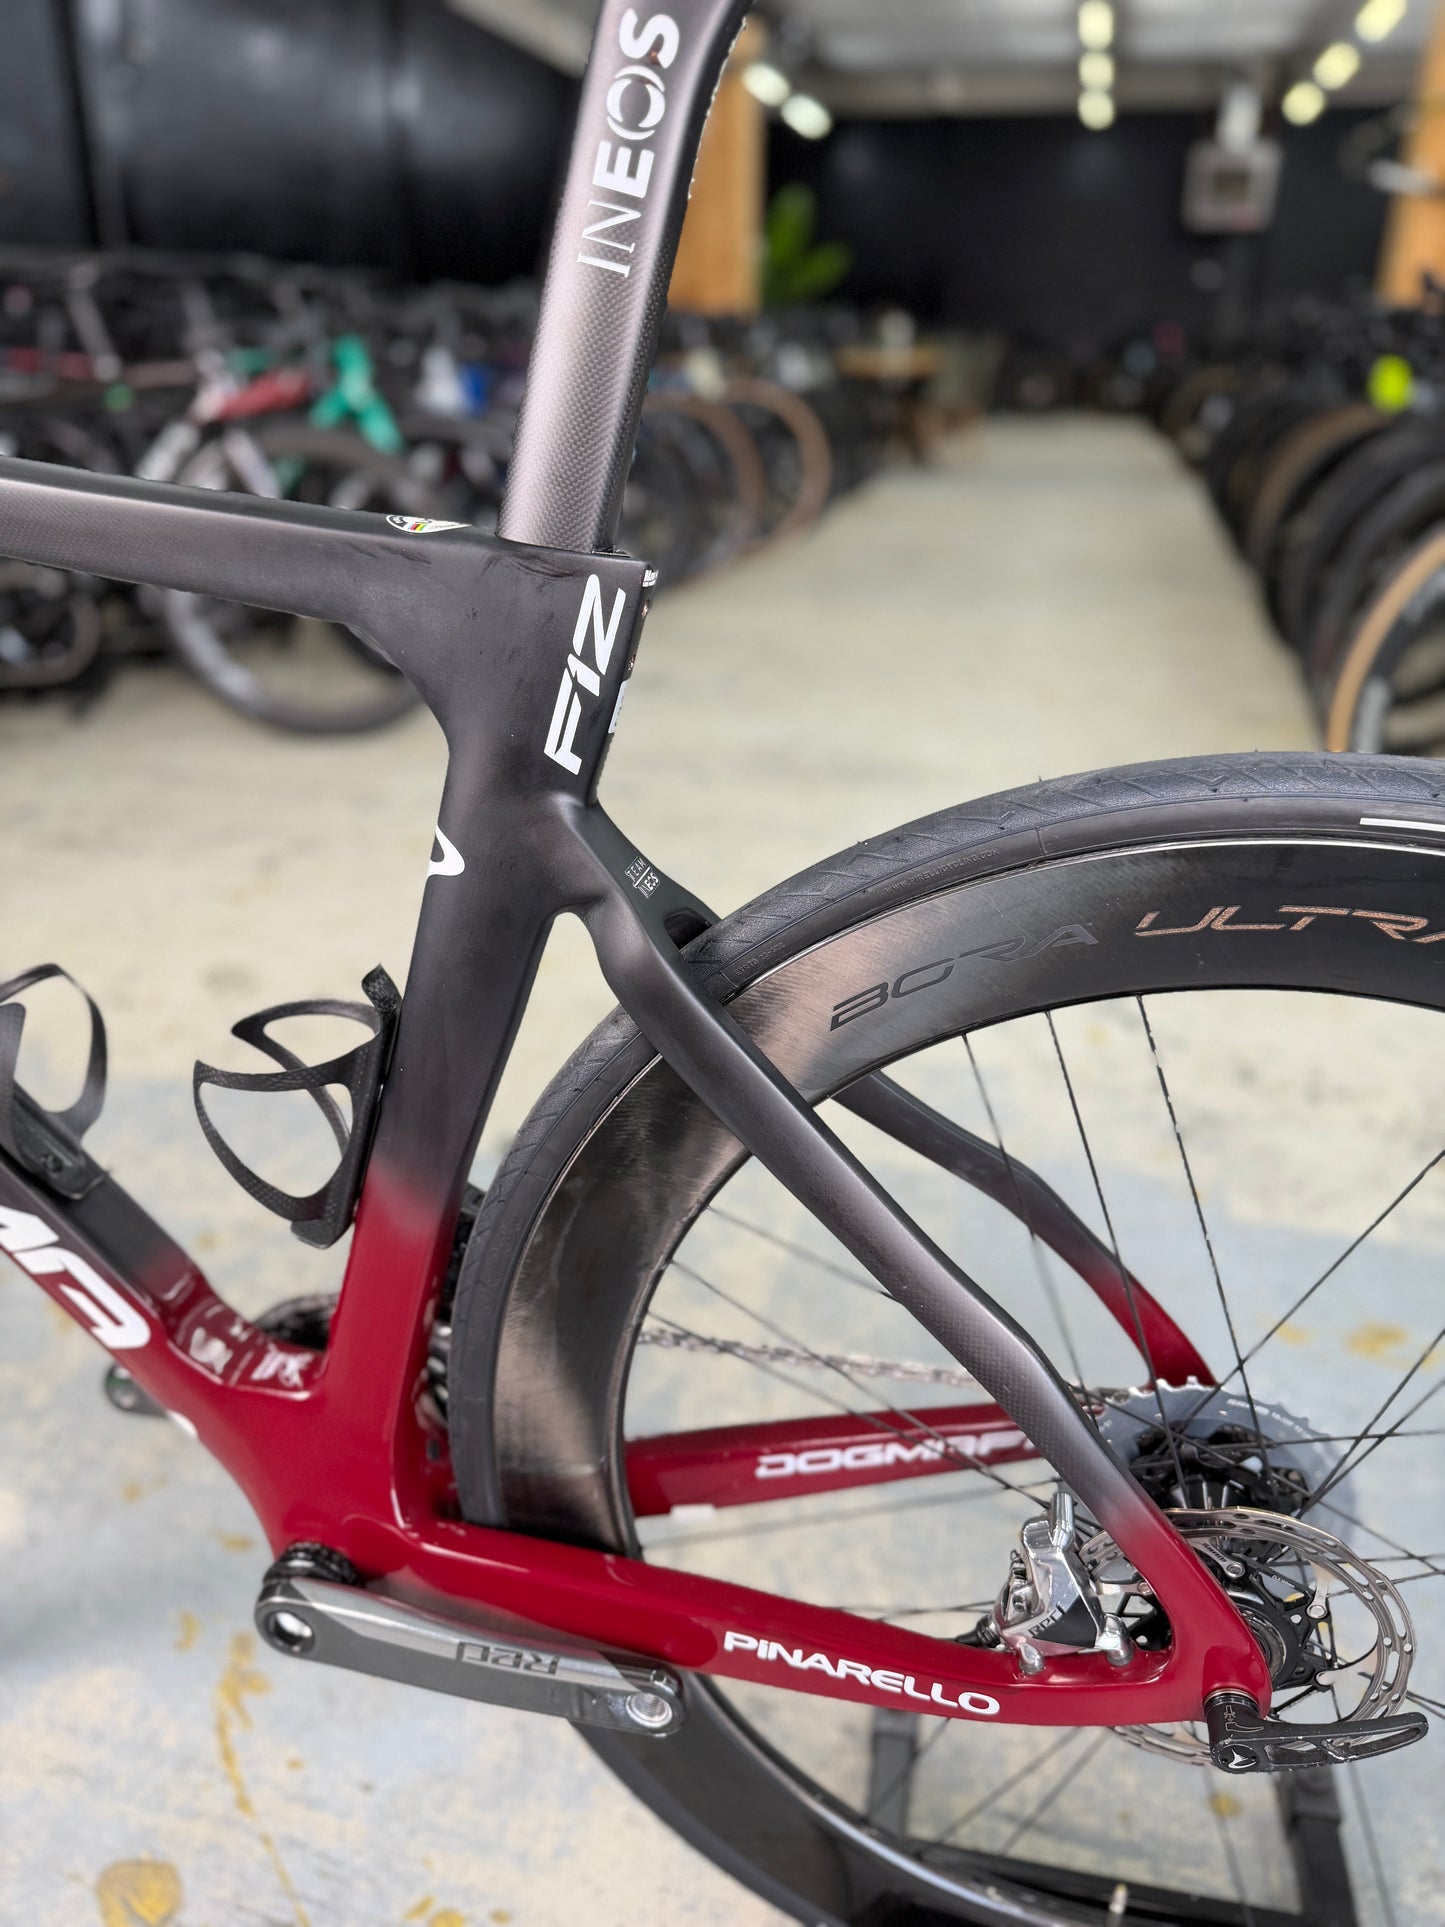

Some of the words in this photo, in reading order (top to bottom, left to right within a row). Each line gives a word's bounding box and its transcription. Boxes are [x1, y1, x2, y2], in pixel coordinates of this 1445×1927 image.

[577, 7, 680, 278] INEOS
[543, 573, 627, 776] F12
[829, 922, 1099, 1033] BORA
[456, 1641, 561, 1675] RED
[723, 1630, 1001, 1716] PINARELLO
